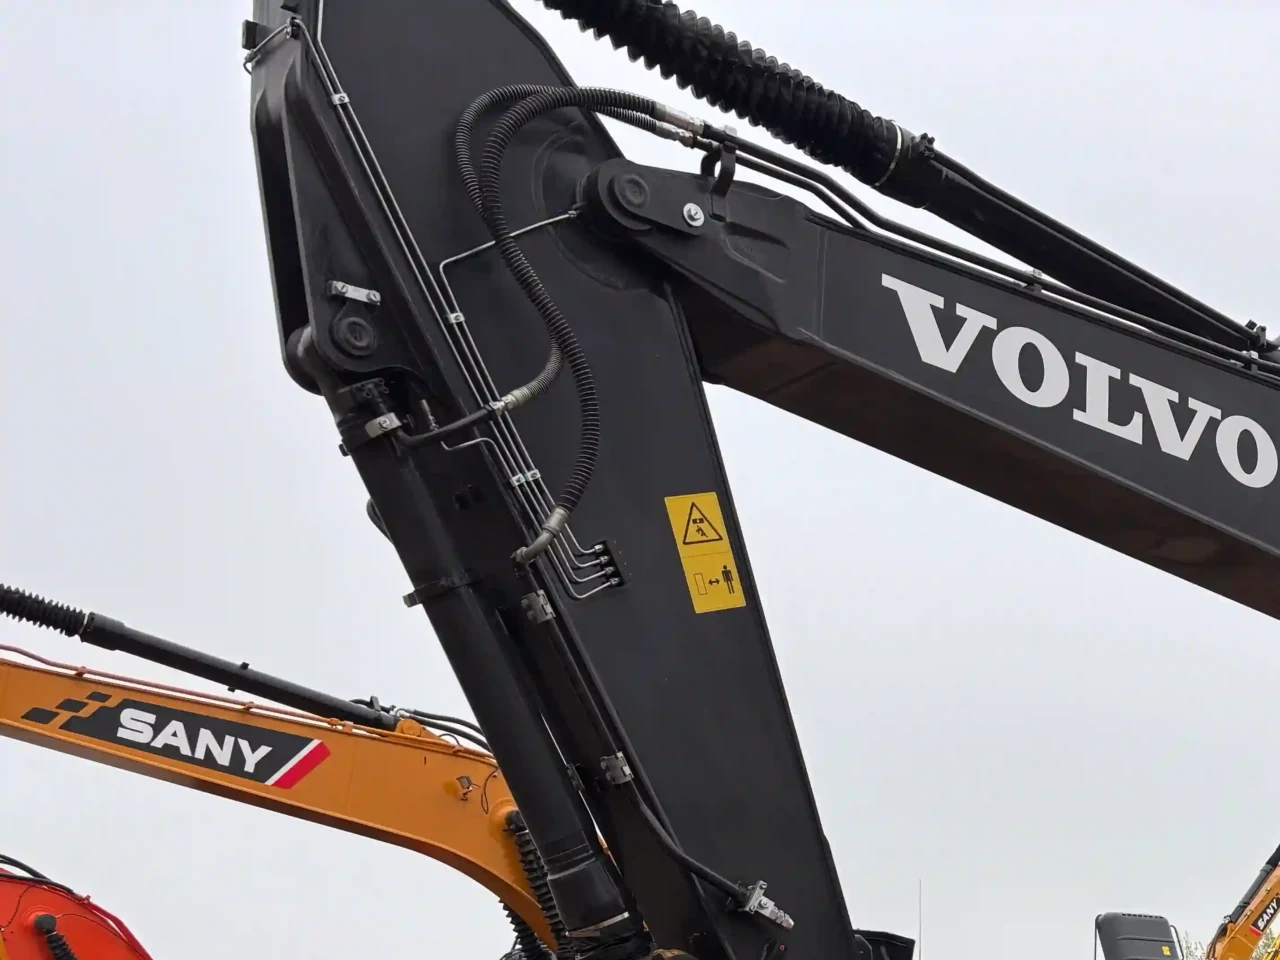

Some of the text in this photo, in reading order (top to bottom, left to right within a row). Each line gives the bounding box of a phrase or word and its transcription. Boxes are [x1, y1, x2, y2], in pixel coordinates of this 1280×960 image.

[882, 273, 1278, 488] VOLVO
[116, 707, 273, 773] SANY
[1257, 899, 1279, 930] SANY
